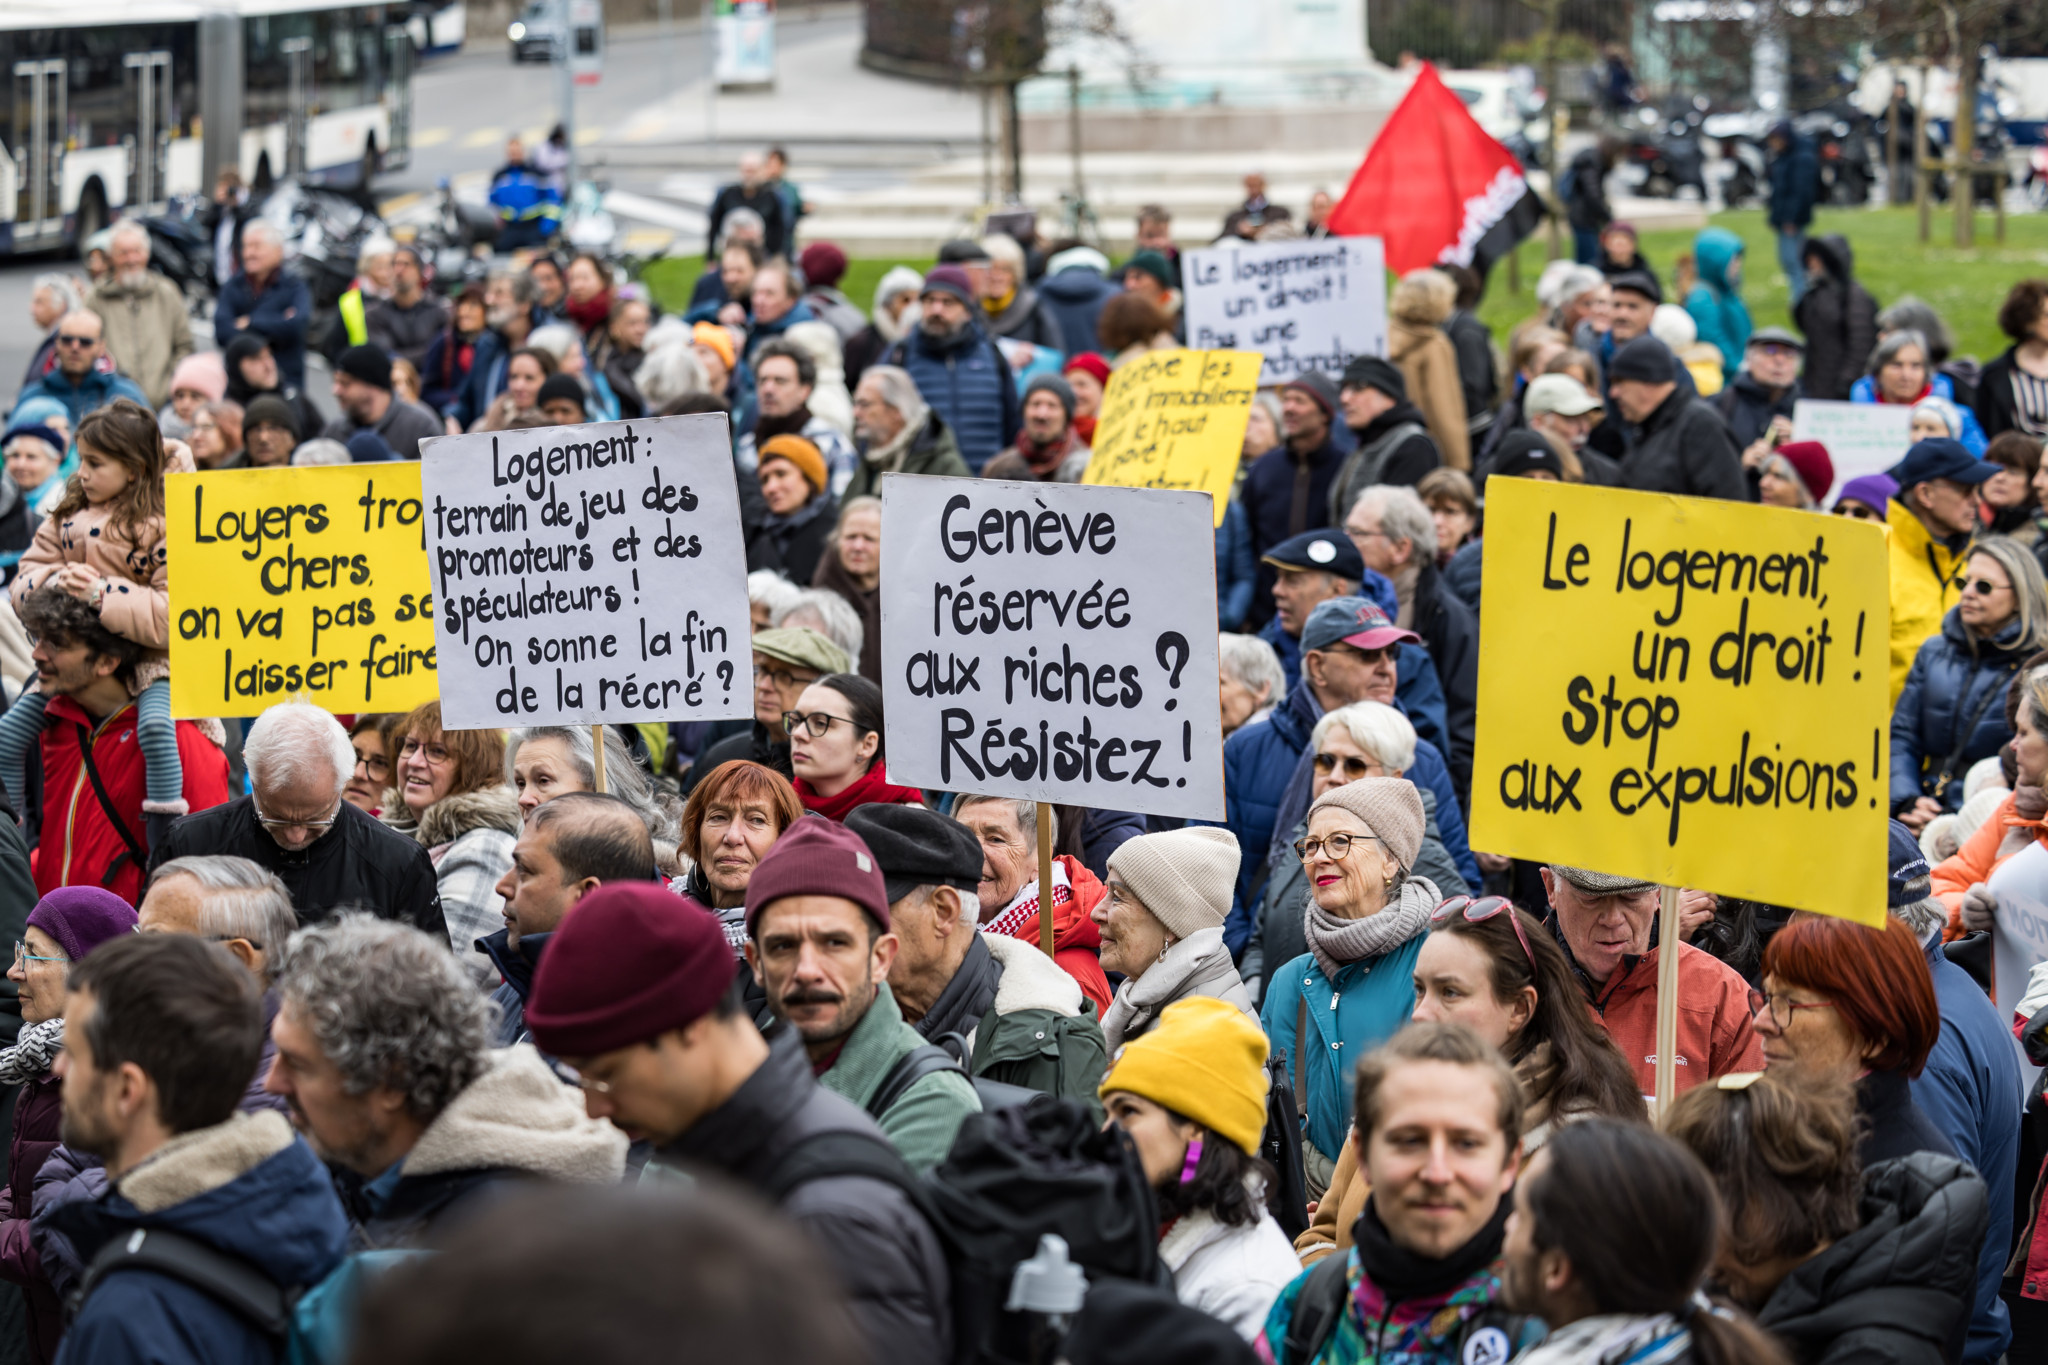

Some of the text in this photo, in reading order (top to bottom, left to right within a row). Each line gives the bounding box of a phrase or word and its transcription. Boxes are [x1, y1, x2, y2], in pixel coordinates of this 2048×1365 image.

[1191, 256, 1221, 286] Le
[1225, 296, 1258, 318] un
[1253, 320, 1298, 345] une
[195, 484, 330, 561] Loyers
[432, 465, 699, 540] terrain de jeu des
[940, 494, 1117, 563] Genève
[436, 517, 703, 599] promoteurs et des
[1543, 511, 1829, 627] Le logement,
[178, 606, 220, 640] on
[236, 607, 283, 640] va
[311, 597, 375, 657] pas
[934, 574, 1131, 637] réservée
[224, 634, 438, 702] laisser faire
[474, 610, 727, 682] On sonne la fin
[905, 649, 981, 699] aux
[1633, 630, 1691, 683] un
[495, 665, 539, 715] de
[556, 667, 584, 712] la
[940, 707, 1192, 788] Résistez!
[1562, 675, 1680, 772] Stop
[1499, 759, 1582, 814] aux
